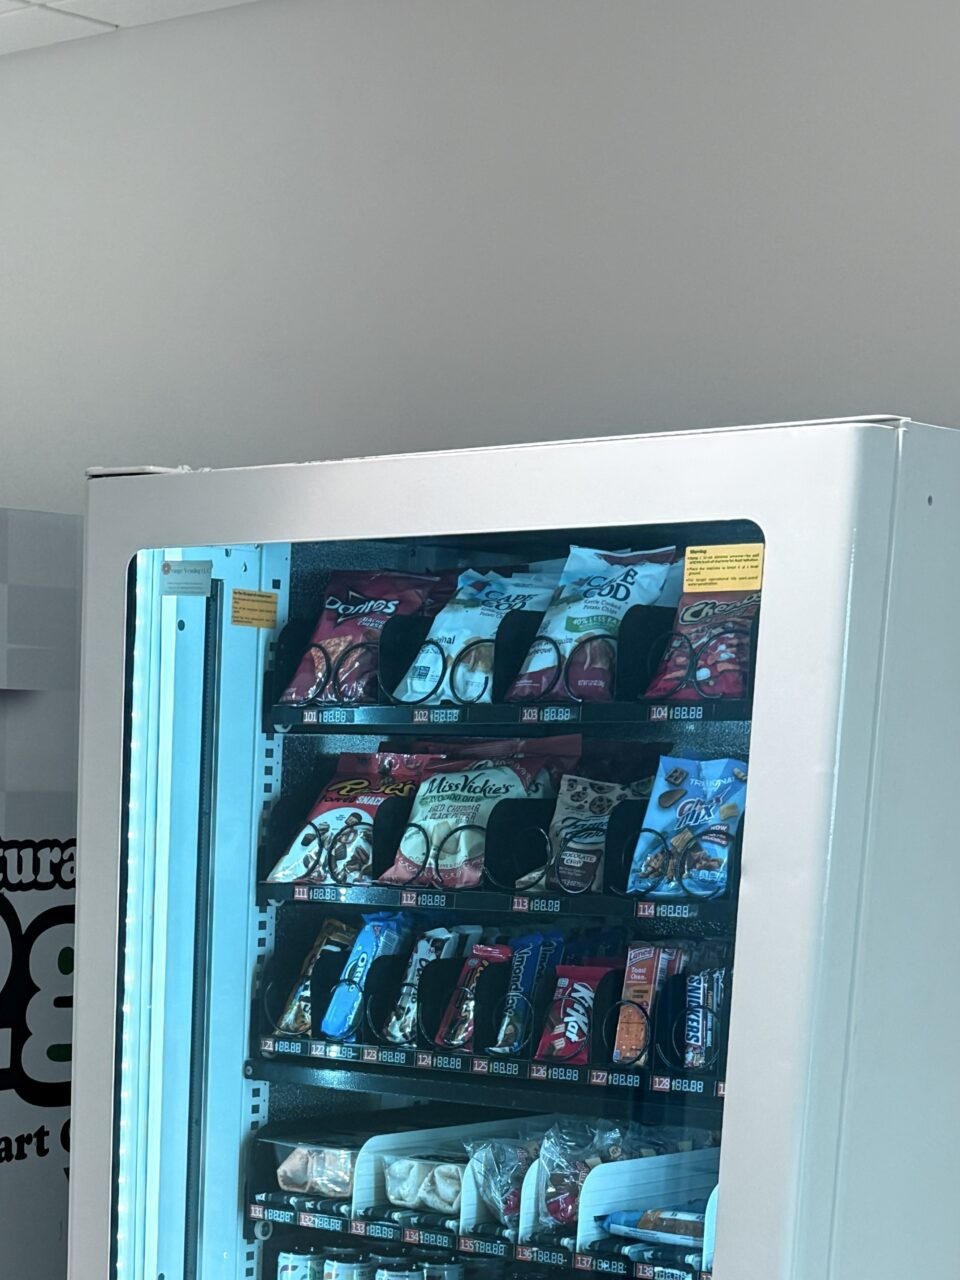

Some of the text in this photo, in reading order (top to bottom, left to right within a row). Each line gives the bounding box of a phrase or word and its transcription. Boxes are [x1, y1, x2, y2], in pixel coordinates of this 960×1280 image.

[325, 596, 400, 615] Doritos
[304, 712, 317, 722] 101
[414, 711, 428, 721] 102
[522, 708, 538, 720] 103
[651, 706, 668, 719] 104
[295, 888, 308, 898] 111
[402, 894, 416, 904] 112
[513, 898, 528, 910] 113
[639, 904, 655, 916] 114
[686, 976, 704, 1045] SNICKERS
[262, 1040, 274, 1050] 121
[311, 1044, 324, 1055] 122
[363, 1049, 377, 1060] 123
[417, 1055, 432, 1066] 124
[473, 1061, 488, 1072] 125
[532, 1066, 546, 1077] 126
[592, 1072, 607, 1083] 127
[654, 1078, 670, 1089] 128
[250, 1206, 263, 1218] 131
[300, 1214, 314, 1226] 132
[352, 1222, 365, 1234] 133
[405, 1230, 418, 1242] 134
[460, 1239, 474, 1252] 135
[517, 1247, 532, 1260] 136
[576, 1256, 590, 1270] 137
[638, 1265, 653, 1278] 138
